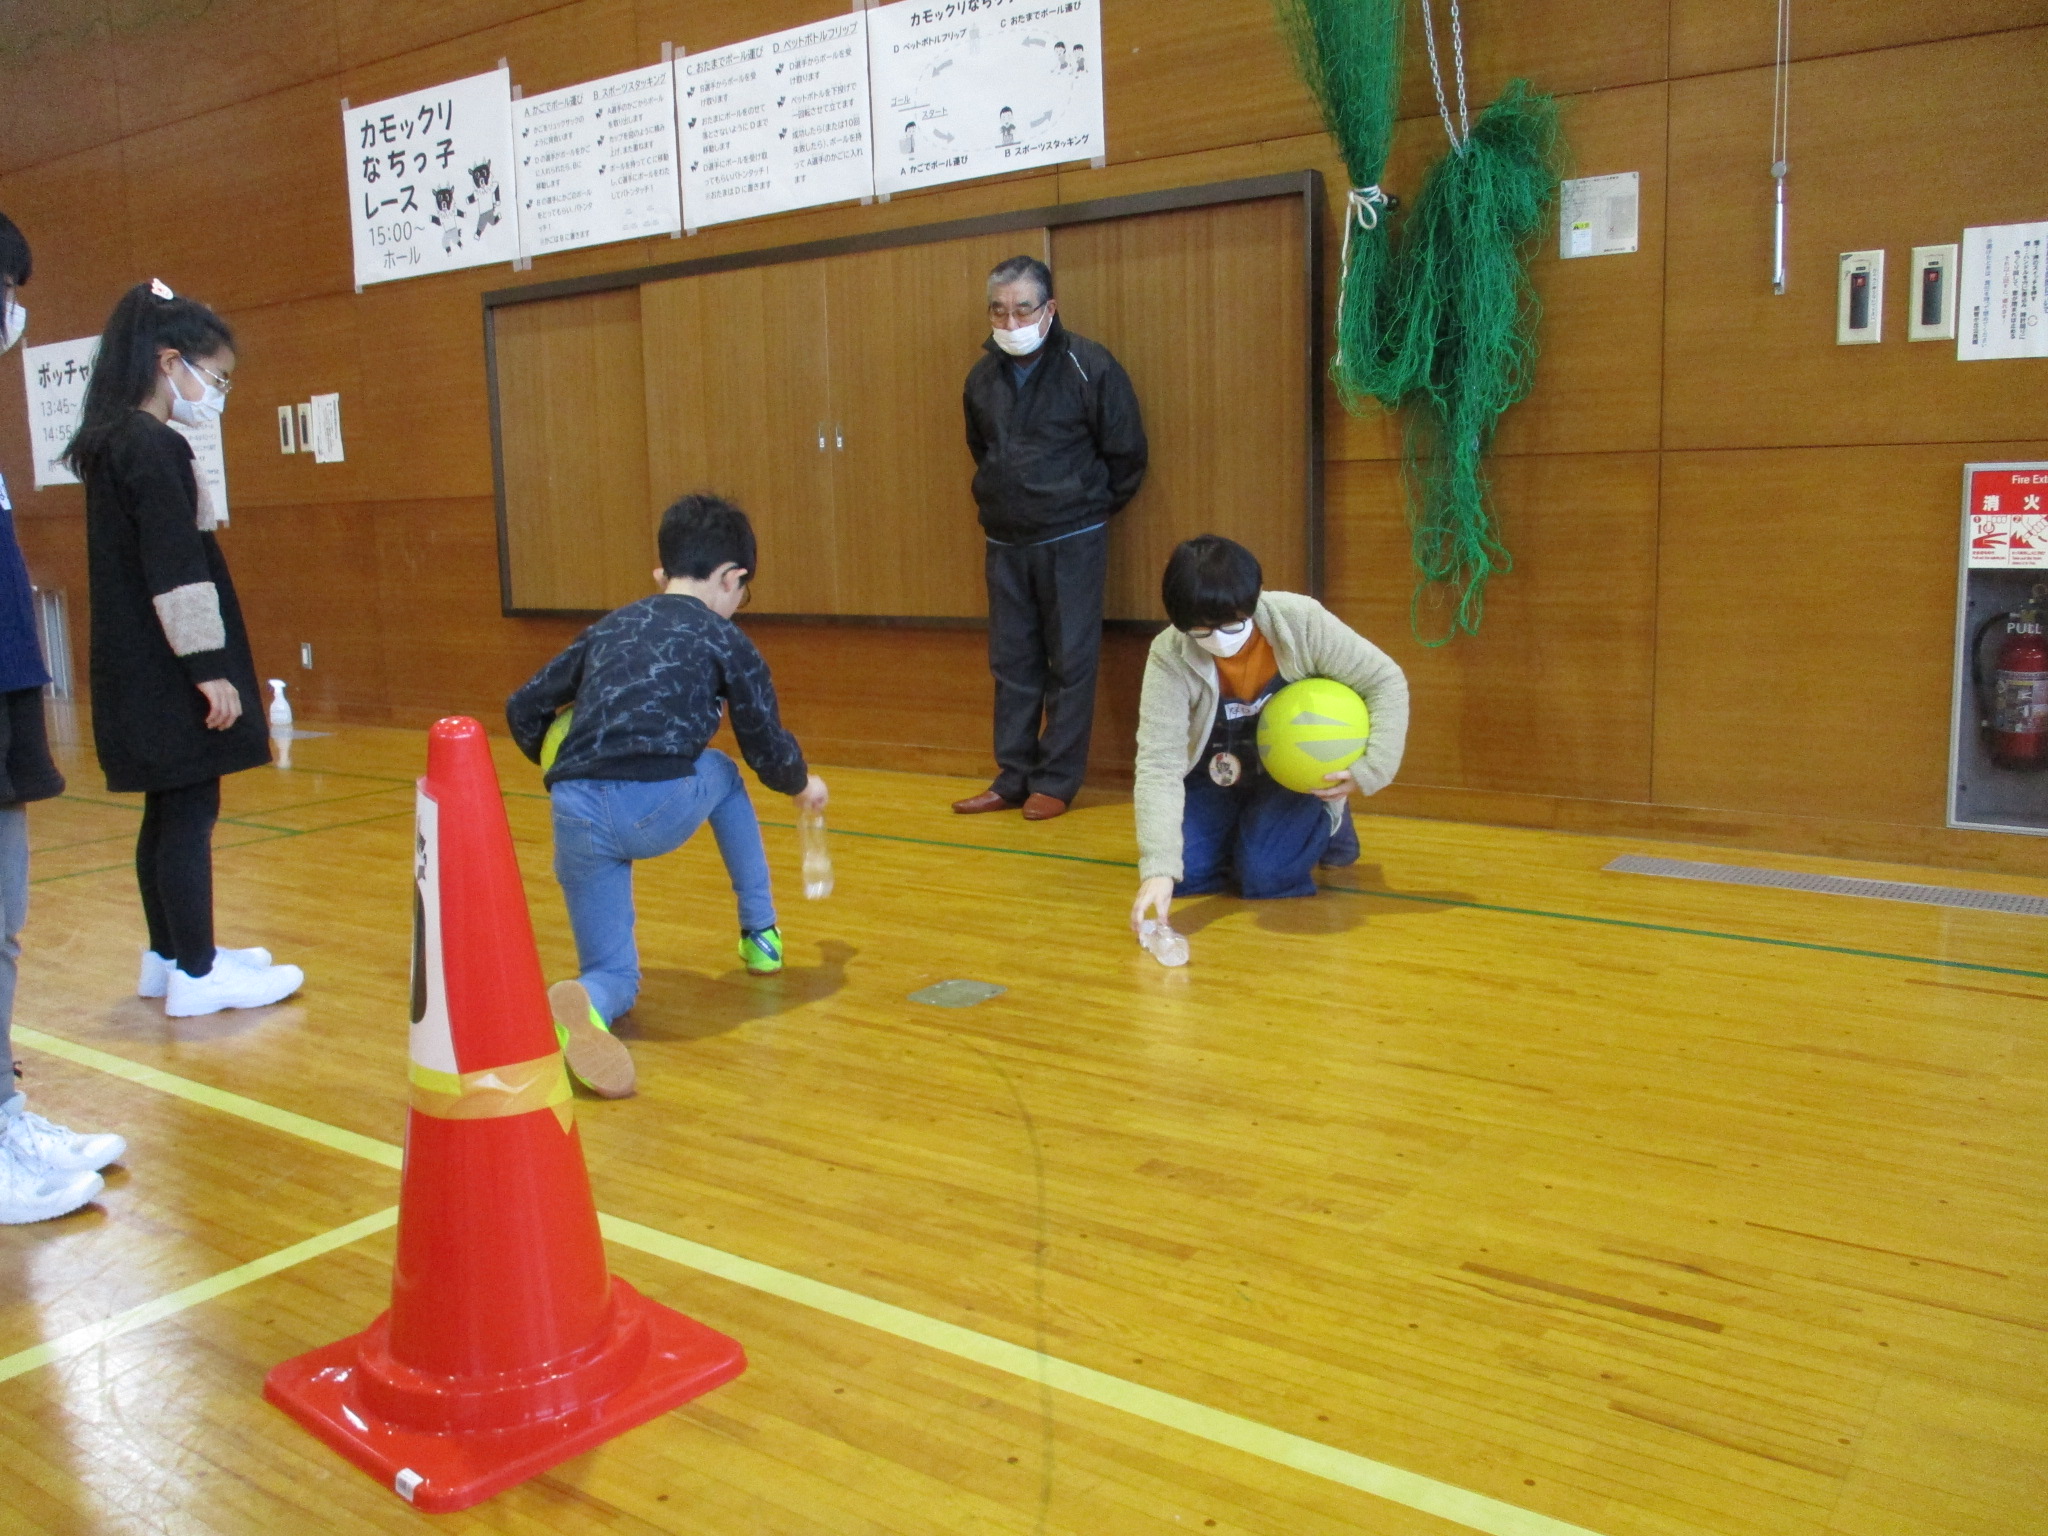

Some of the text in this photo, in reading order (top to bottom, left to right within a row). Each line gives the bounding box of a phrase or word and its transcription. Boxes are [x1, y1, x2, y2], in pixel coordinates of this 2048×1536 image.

[1000, 2, 1081, 28] C おたまでボール運び
[773, 21, 858, 53] D ペットボトルフリップ
[893, 28, 967, 53] D ペットボトルフリップ
[687, 46, 763, 76] C おたまでボール運び
[593, 73, 666, 100] B スポーツスタッキング
[361, 100, 452, 148] カモックリ
[525, 107, 530, 118] A
[922, 107, 948, 119] スタート
[1005, 134, 1089, 158] B スポーツスタッキング
[363, 138, 455, 183] なちっ子
[900, 155, 968, 176] A かごでボール運び
[365, 185, 418, 219] レース
[369, 221, 425, 246] 15:00～
[384, 246, 421, 269] ホール
[2012, 475, 2030, 484] Fire
